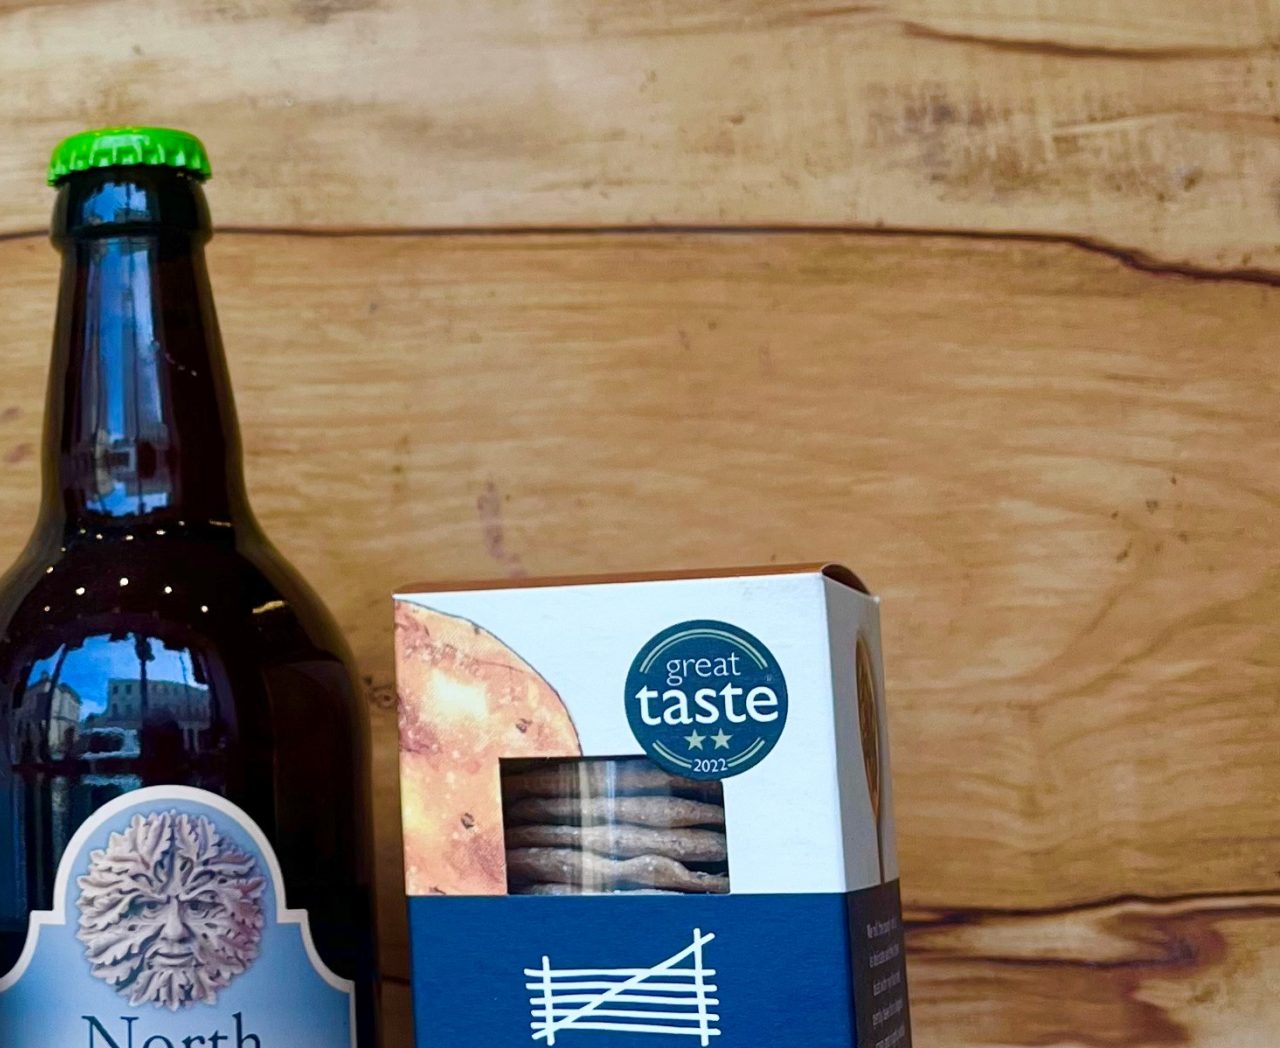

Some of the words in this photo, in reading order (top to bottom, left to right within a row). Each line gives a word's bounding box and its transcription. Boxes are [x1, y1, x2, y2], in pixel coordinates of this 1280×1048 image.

[666, 652, 742, 687] great
[634, 682, 779, 726] taste
[692, 758, 729, 773] 2022
